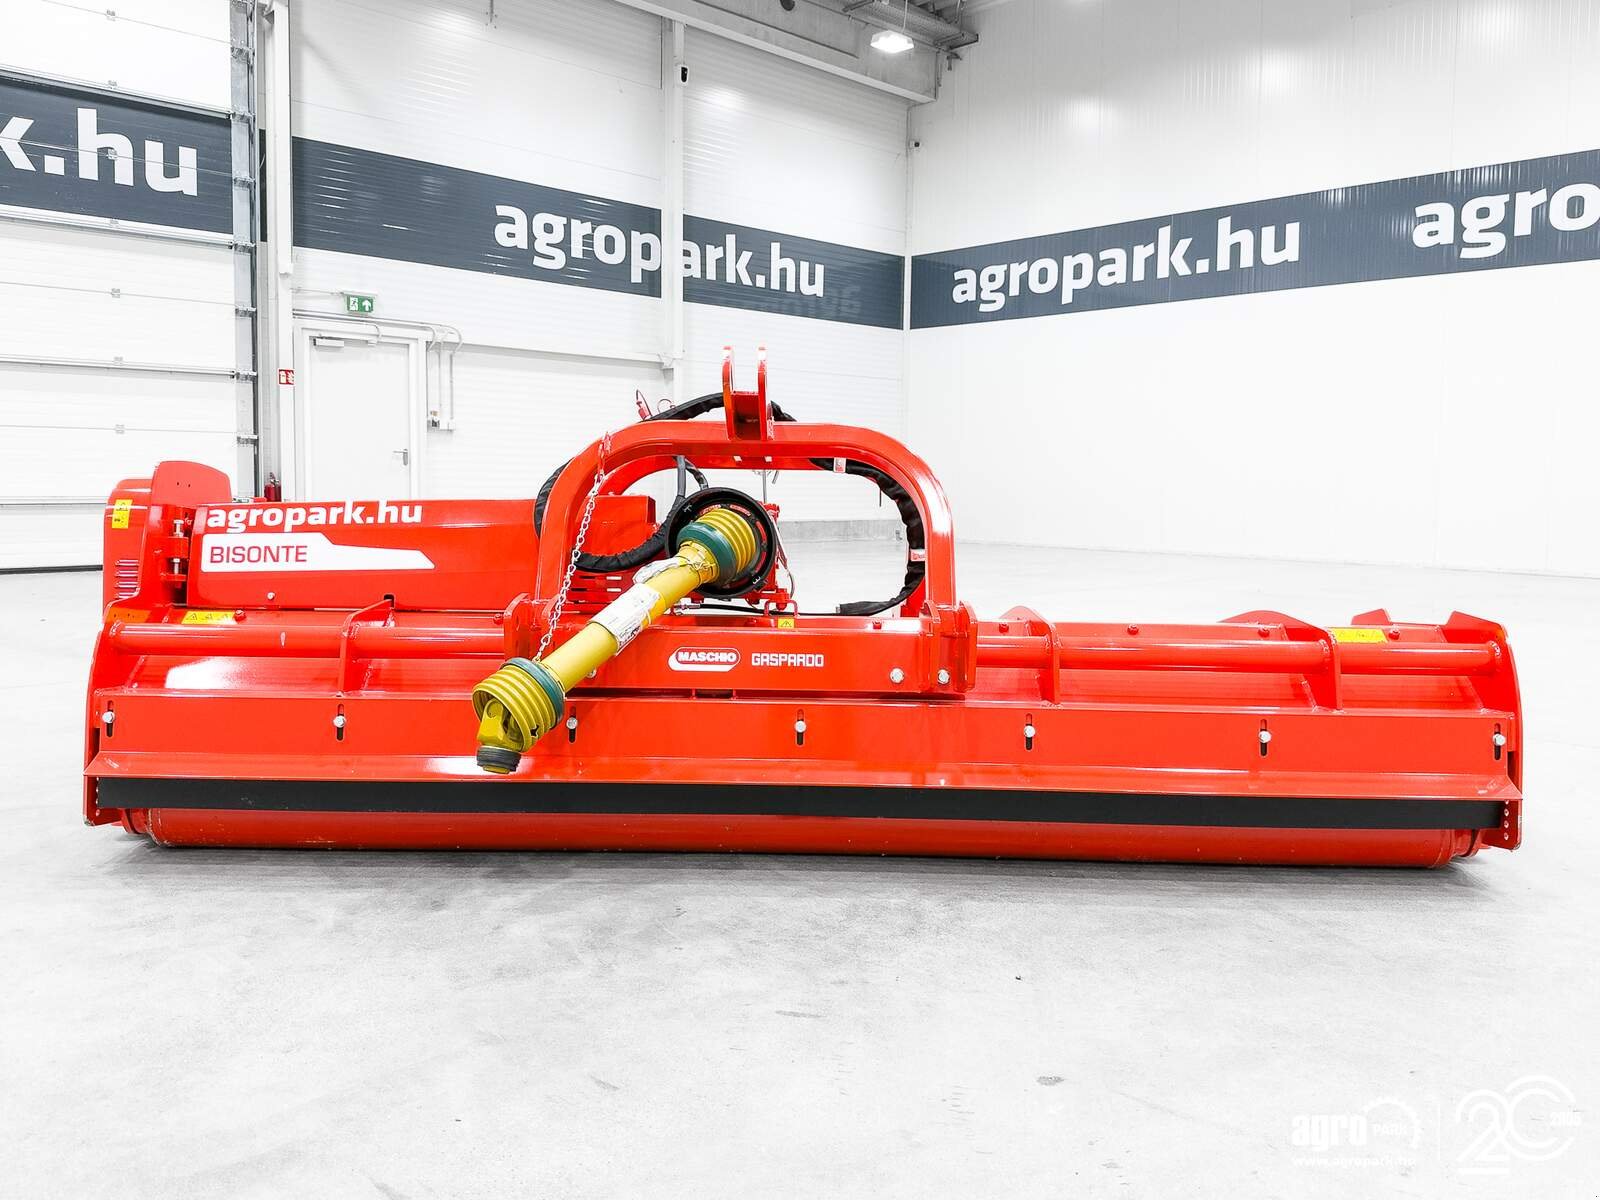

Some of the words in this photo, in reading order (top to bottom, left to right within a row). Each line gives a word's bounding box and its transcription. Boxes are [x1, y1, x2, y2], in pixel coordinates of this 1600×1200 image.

[1412, 183, 1600, 259] agro
[952, 216, 1300, 312] agropark.hu
[206, 500, 422, 533] agropark.hu
[209, 545, 308, 564] BISONTE
[677, 651, 738, 664] MASCHIO
[751, 653, 825, 667] GASPARDO
